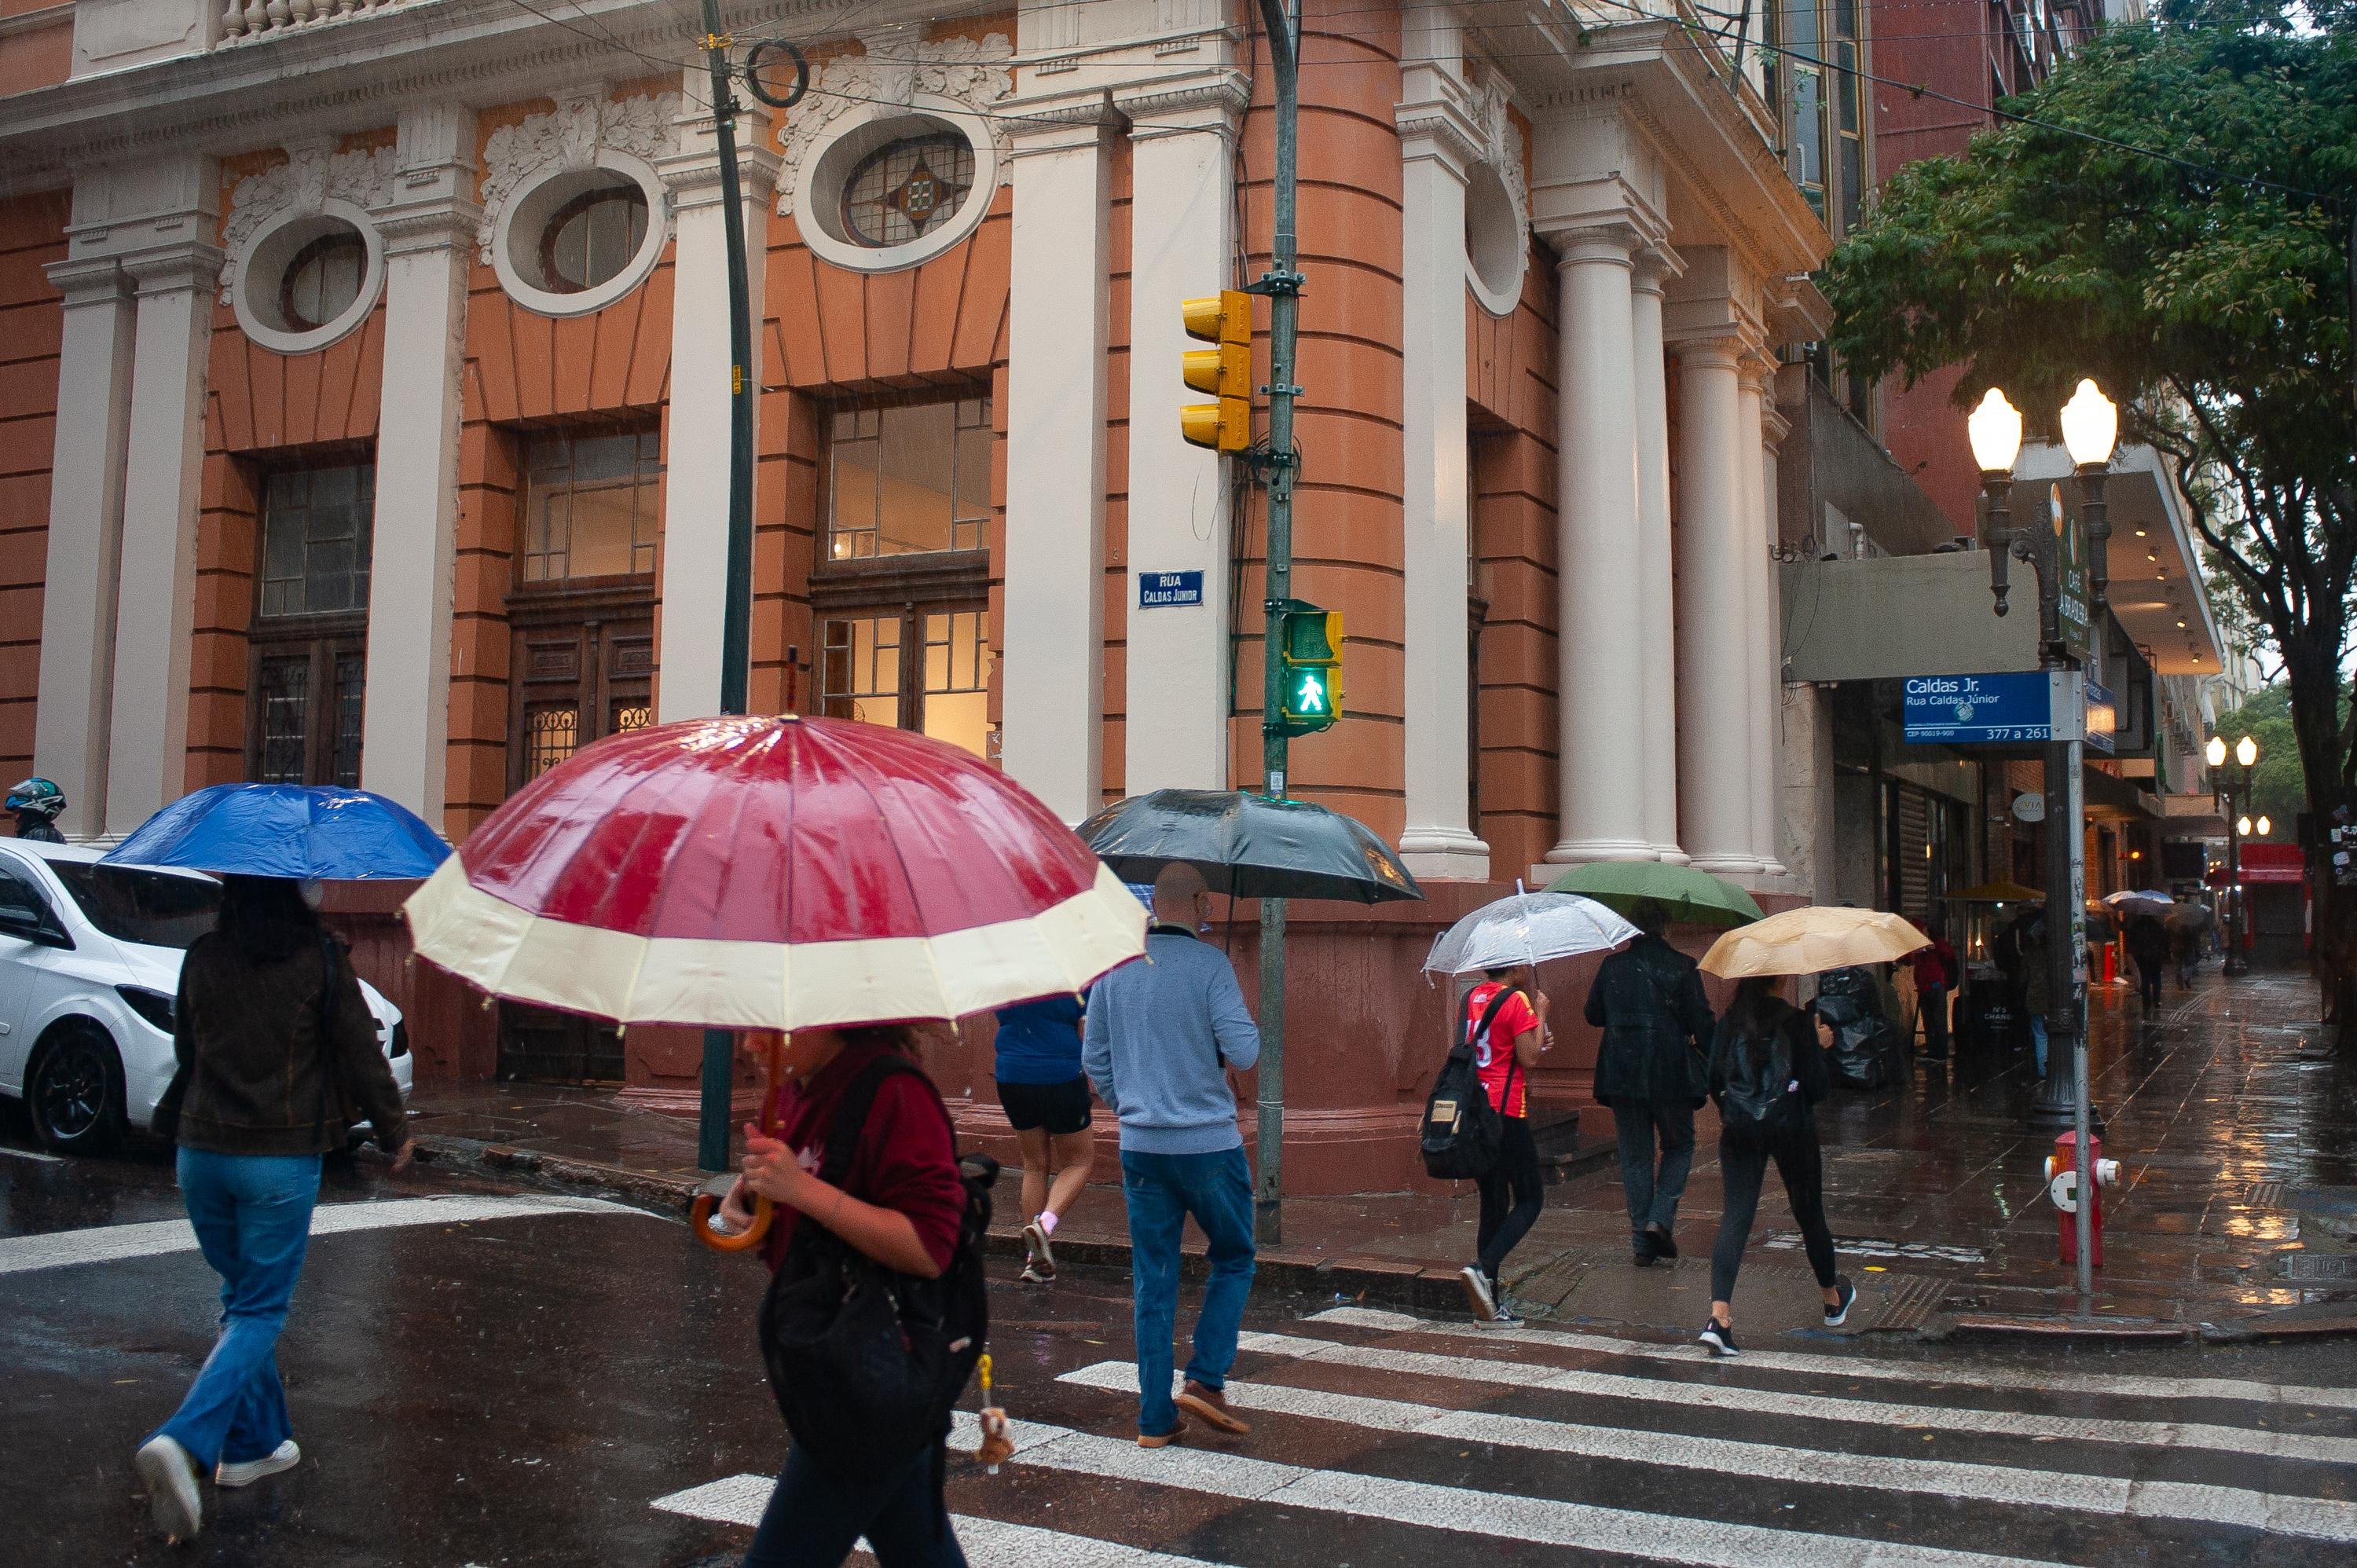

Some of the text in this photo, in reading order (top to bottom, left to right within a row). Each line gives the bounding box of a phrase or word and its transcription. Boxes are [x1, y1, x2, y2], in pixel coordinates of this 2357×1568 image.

[1160, 575, 1181, 587] RUA
[1144, 590, 1171, 603] CALDAS
[1907, 677, 1980, 694] Caldas Jr.
[1906, 694, 2000, 705] Rua Caldas Júnior
[1986, 727, 2048, 739] 377 a 261
